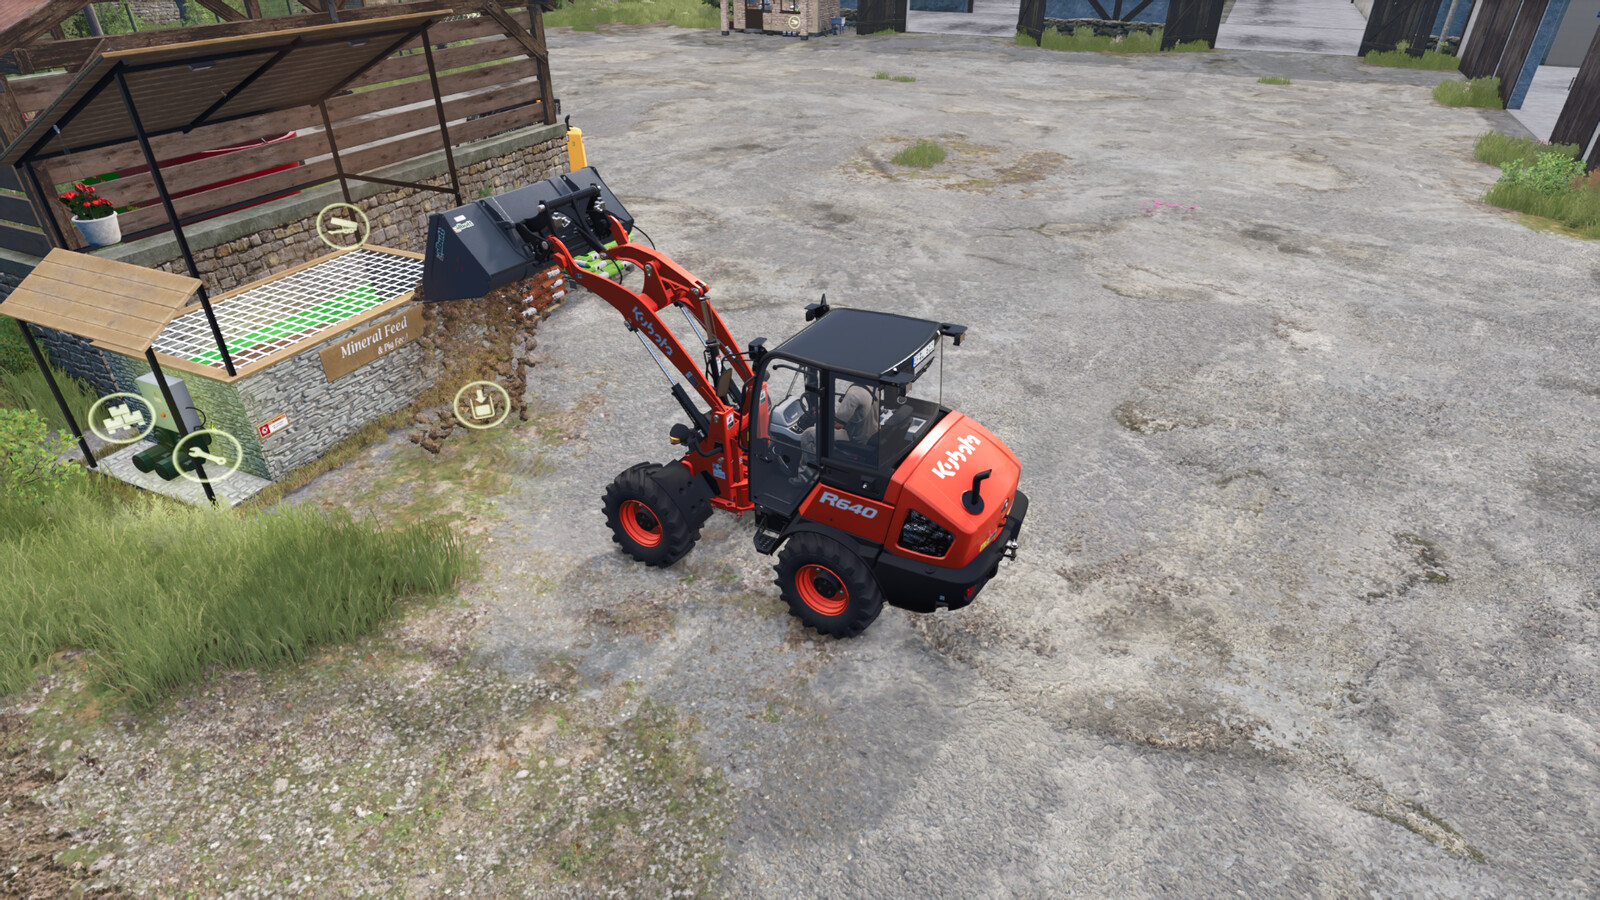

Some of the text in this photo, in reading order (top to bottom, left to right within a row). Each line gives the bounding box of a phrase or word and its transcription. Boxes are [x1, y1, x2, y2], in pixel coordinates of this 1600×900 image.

[341, 316, 408, 358] Mineral Feed
[378, 346, 383, 355] &
[384, 342, 394, 352] Pig
[632, 306, 673, 356] Kubota
[931, 434, 981, 479] Kubota
[818, 491, 878, 519] R640
